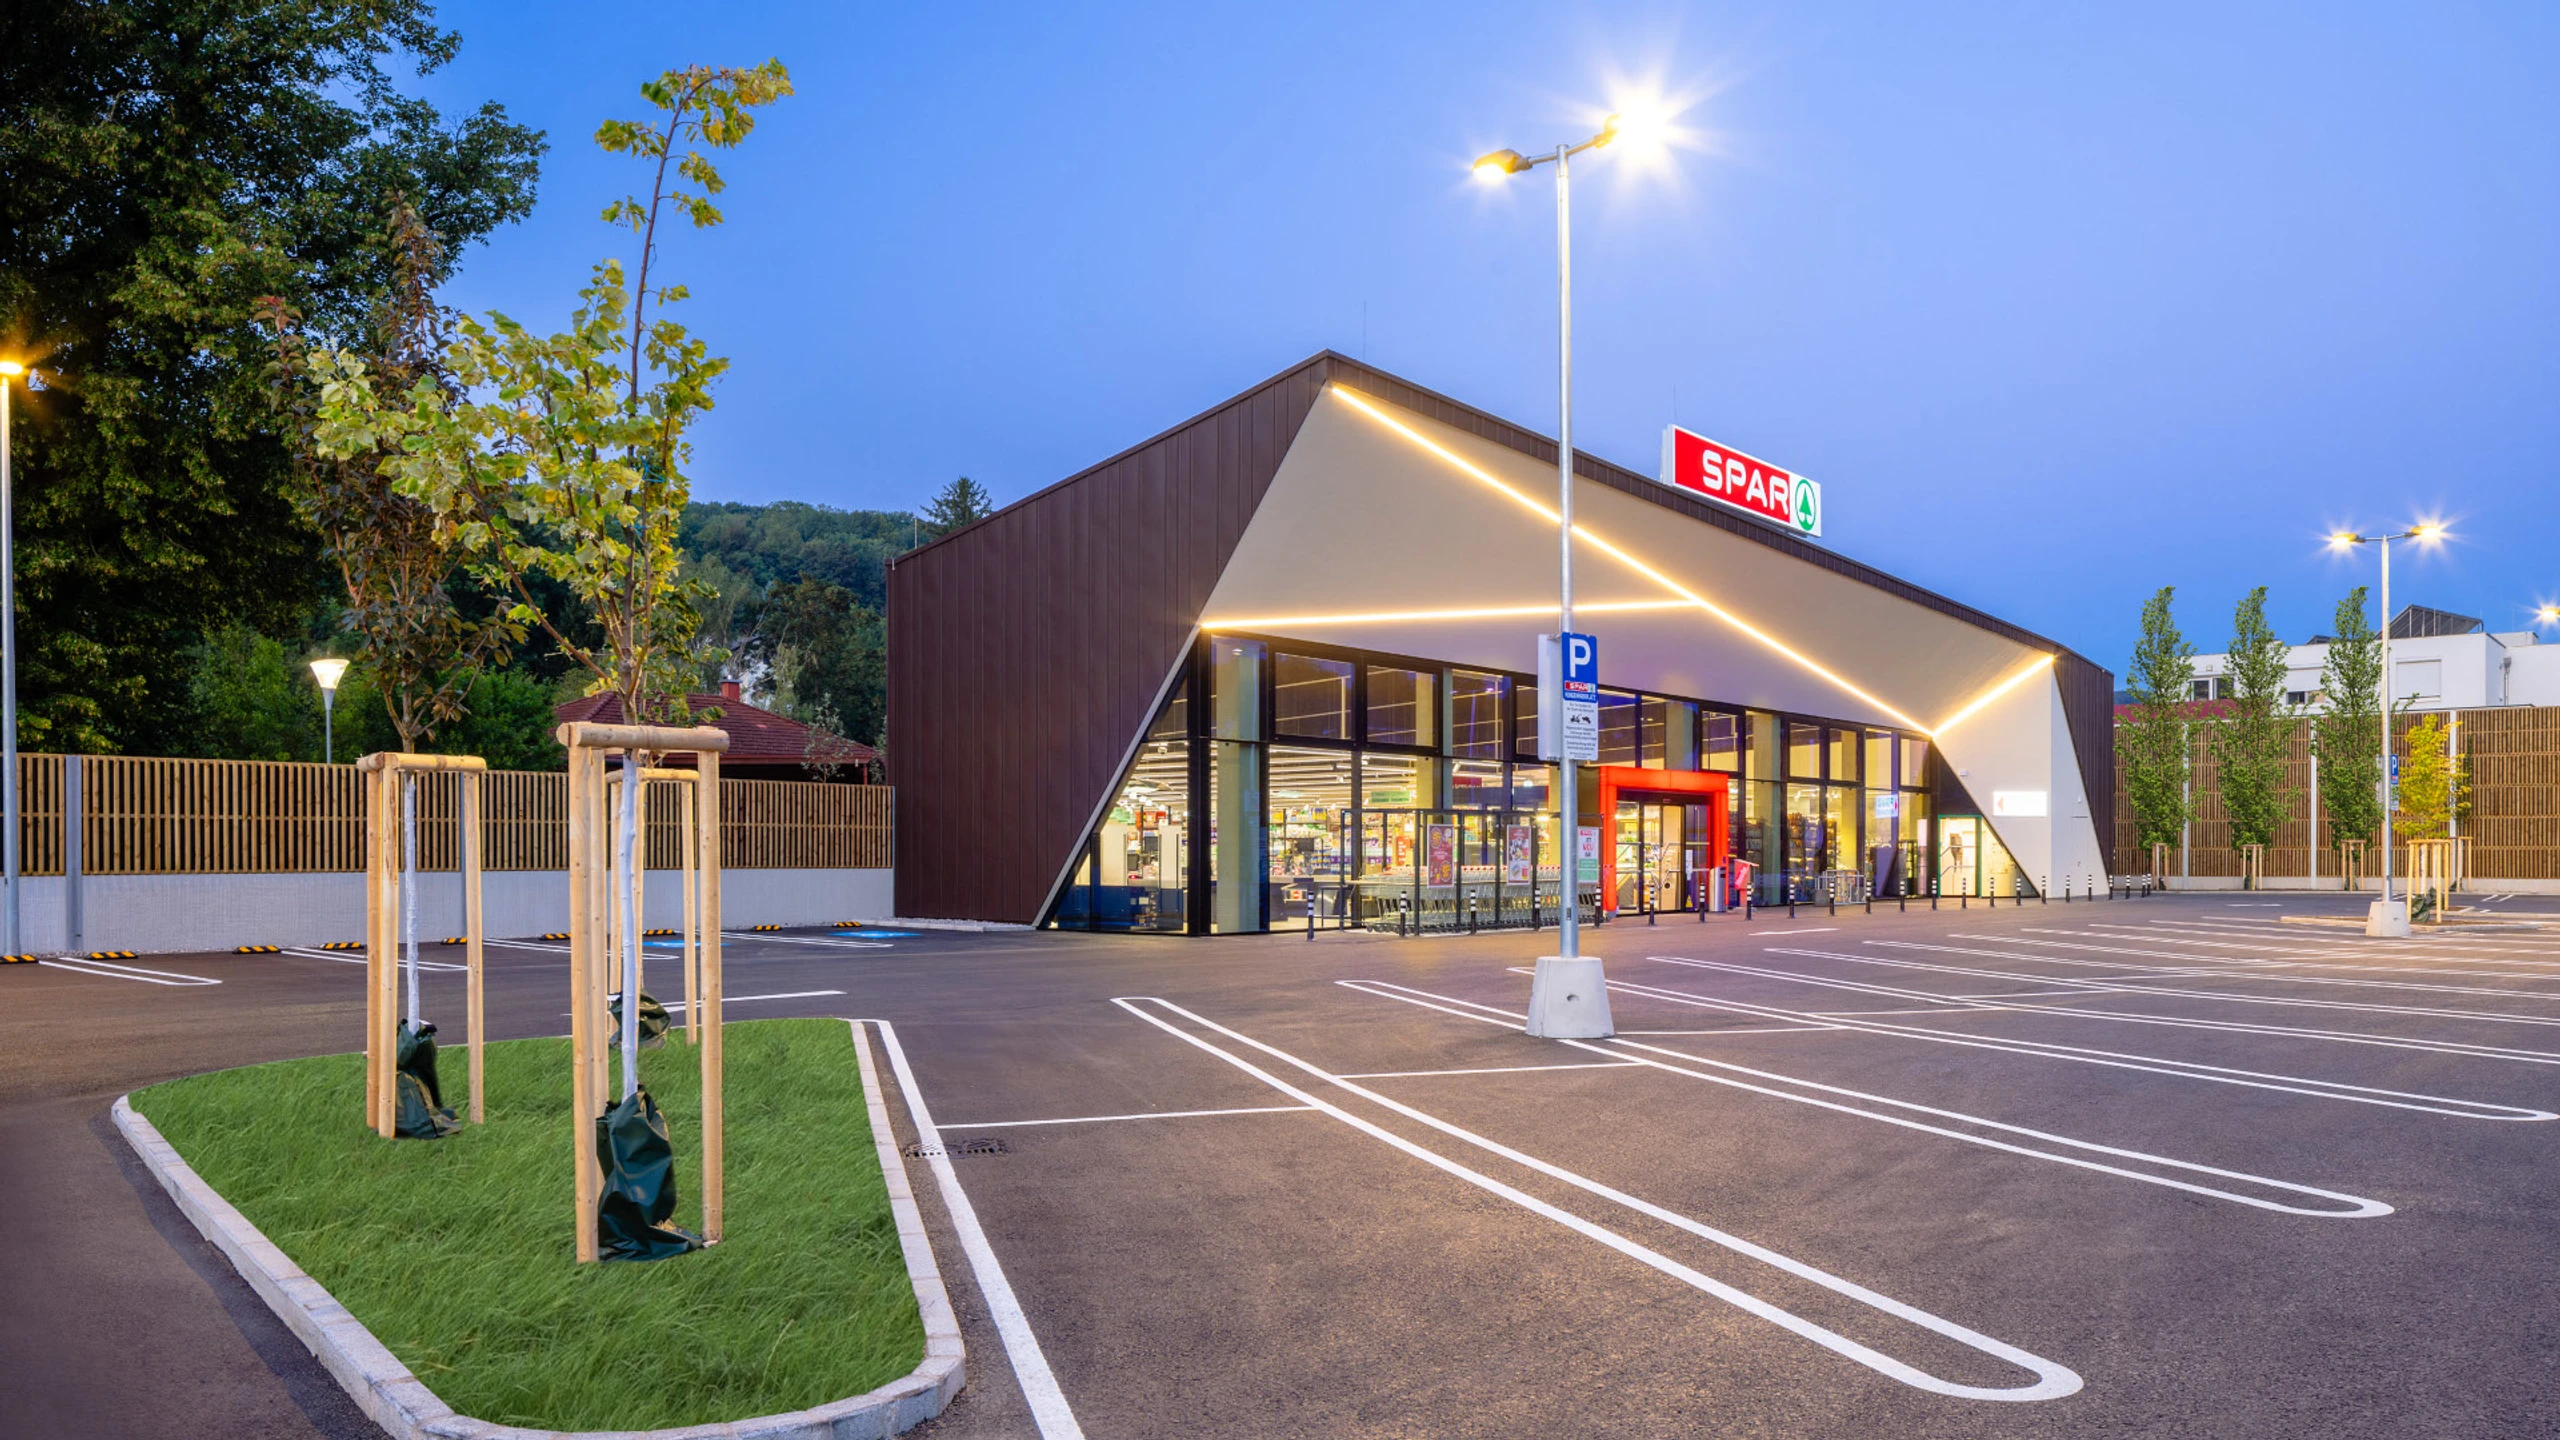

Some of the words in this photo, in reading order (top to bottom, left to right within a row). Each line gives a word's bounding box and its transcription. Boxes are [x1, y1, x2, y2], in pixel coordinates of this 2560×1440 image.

[1702, 449, 1789, 515] SPAR
[1569, 638, 1591, 678] P
[1570, 682, 1588, 691] SPAR
[2392, 756, 2397, 774] P
